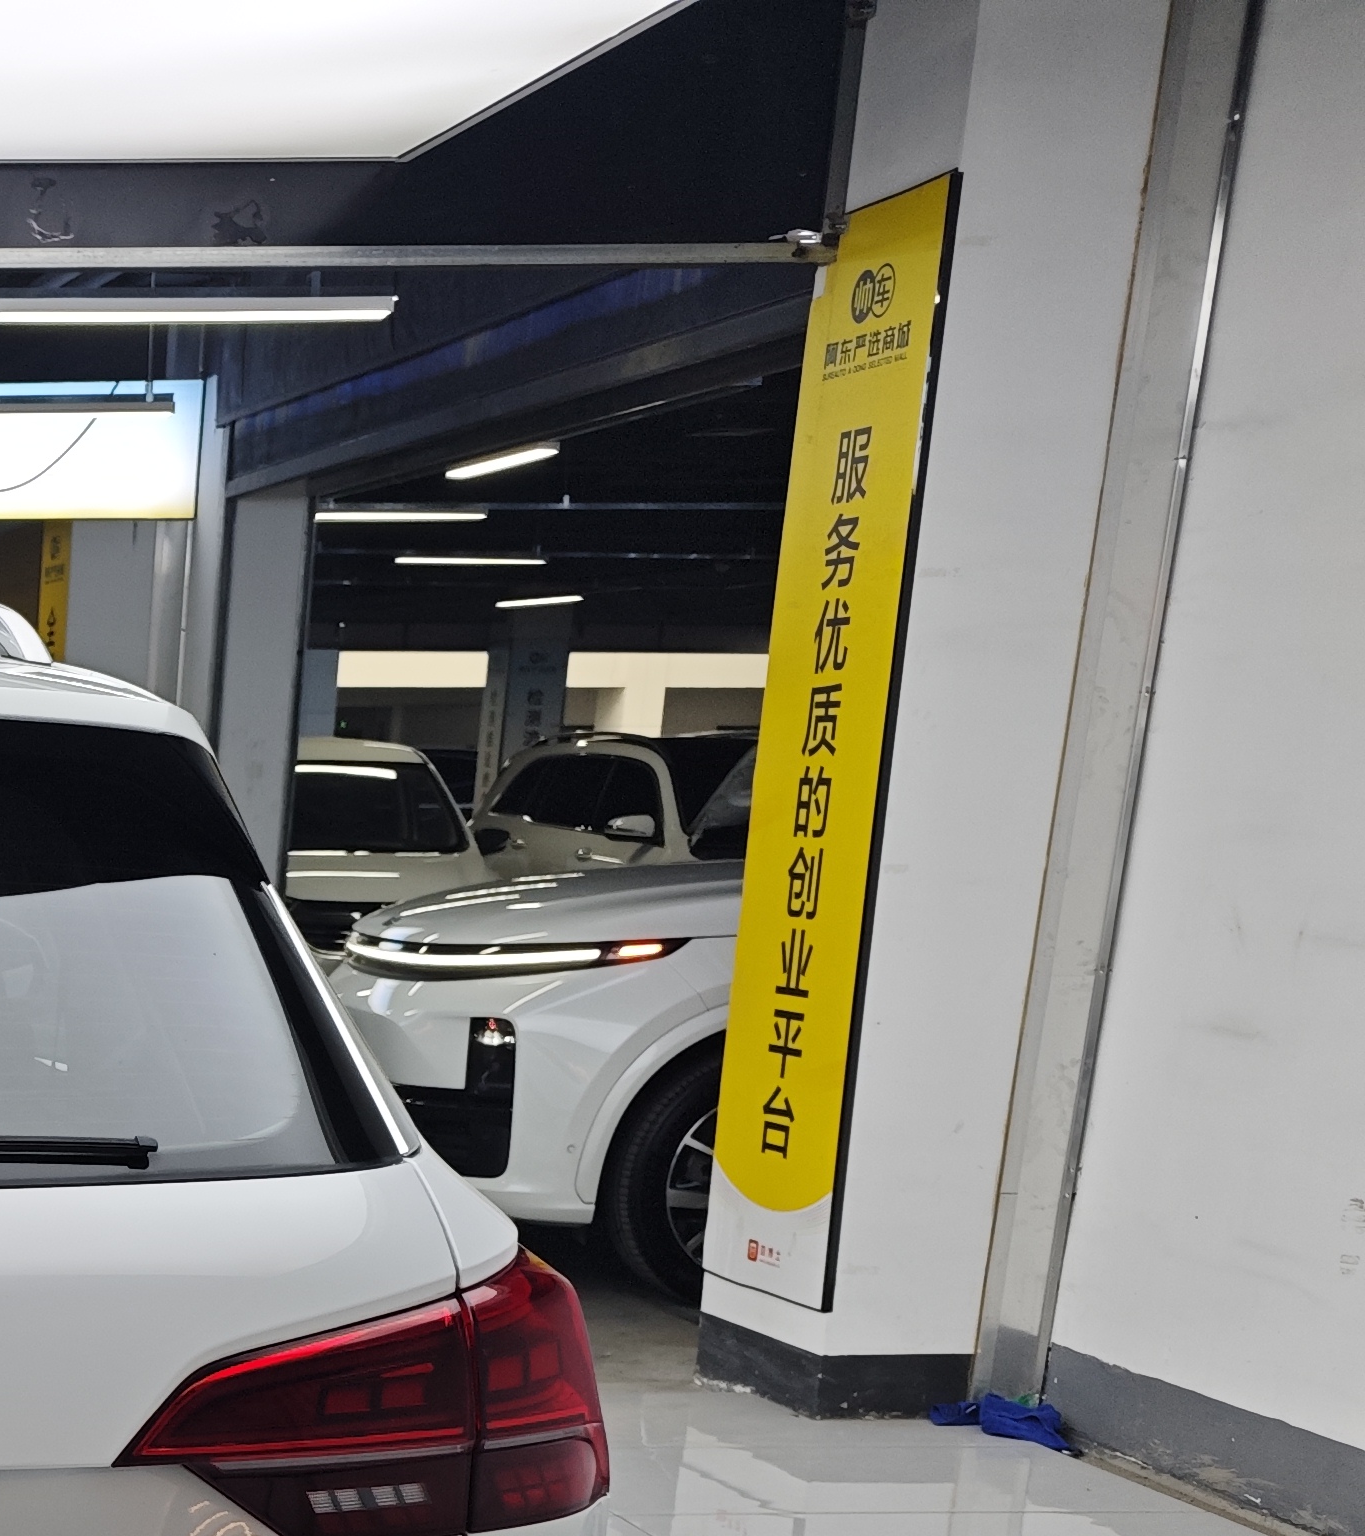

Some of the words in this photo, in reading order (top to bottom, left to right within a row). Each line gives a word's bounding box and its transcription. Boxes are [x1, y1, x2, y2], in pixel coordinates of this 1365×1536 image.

[824, 320, 911, 370] 阿东严选商城
[761, 426, 872, 1159] 服务优质的创业平台
